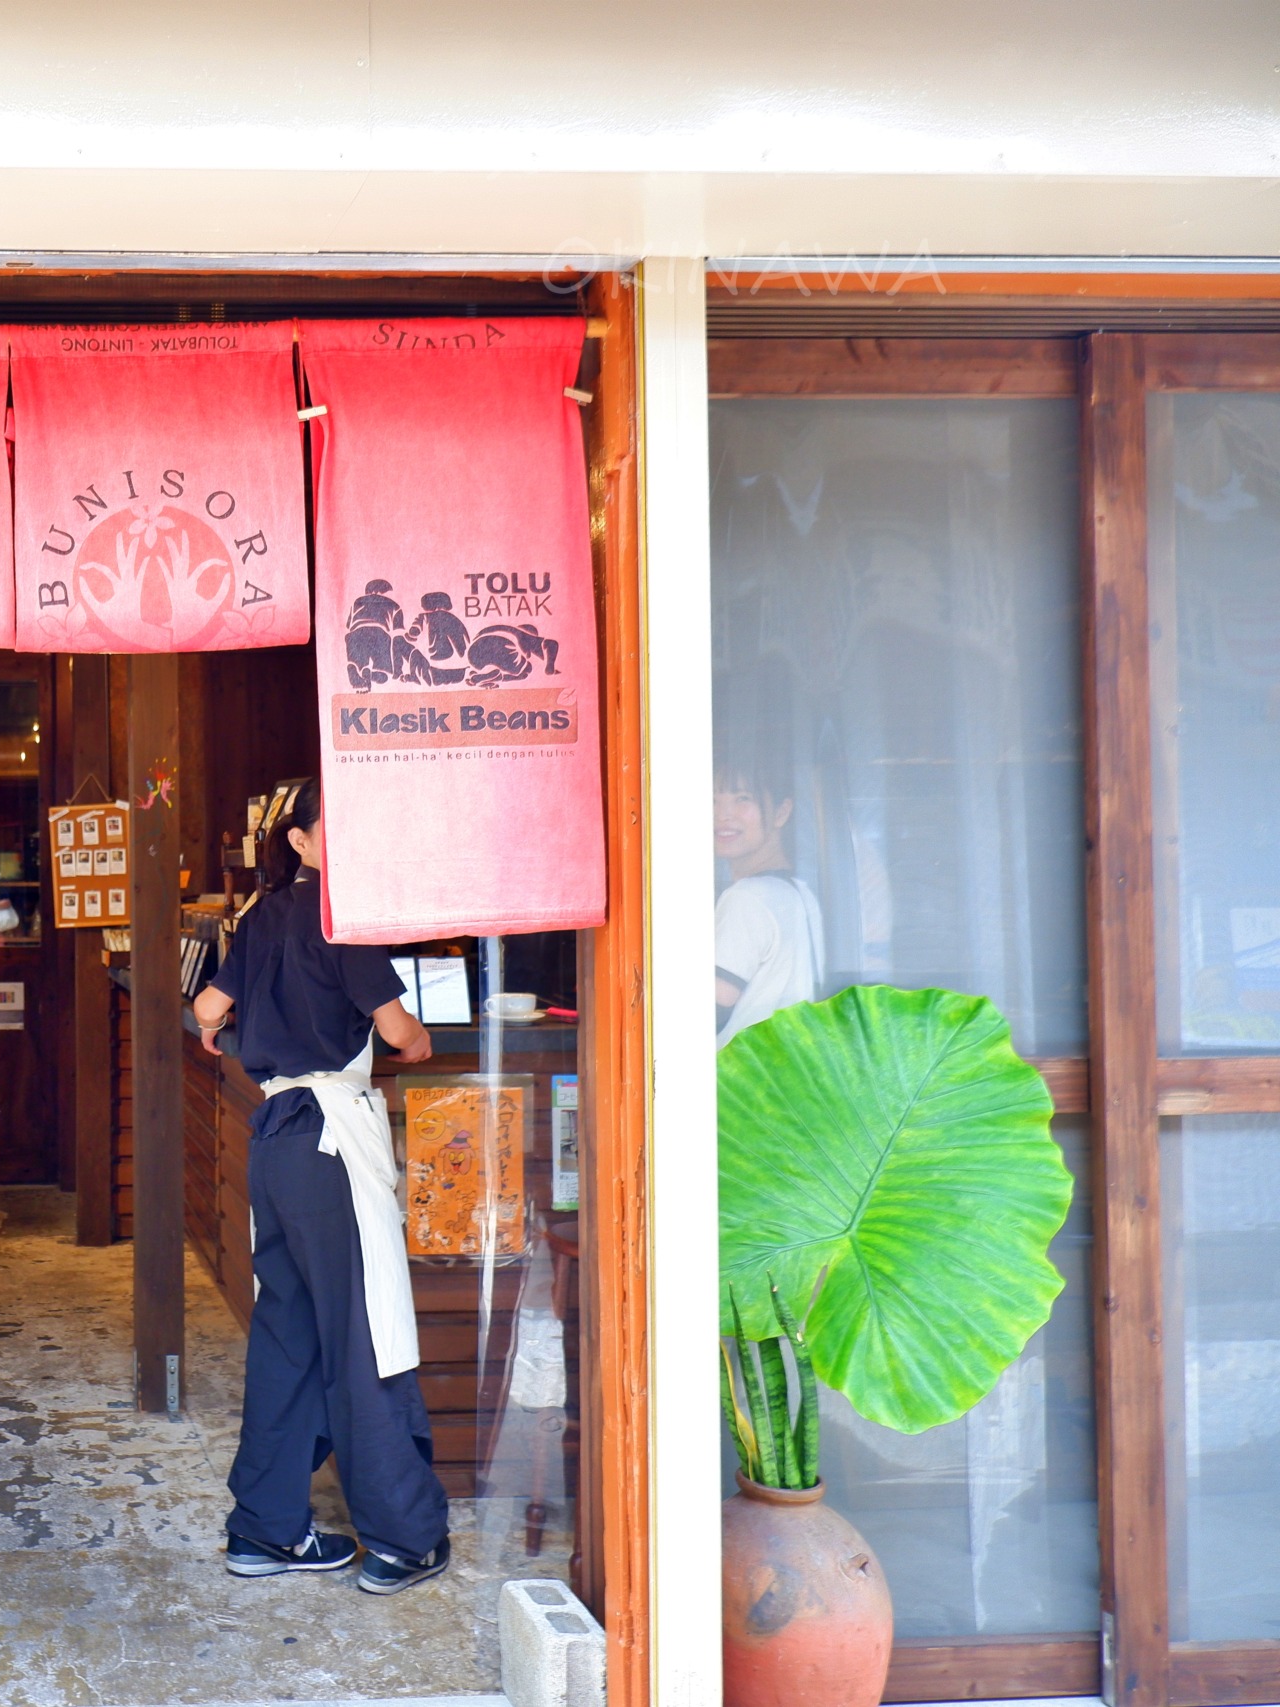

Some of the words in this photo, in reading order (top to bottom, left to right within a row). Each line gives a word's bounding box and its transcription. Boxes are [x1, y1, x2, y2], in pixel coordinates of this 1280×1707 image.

[61, 337, 134, 352] LINTONG
[151, 336, 239, 352] TOLUBATAK
[38, 469, 273, 609] BUNISORA
[464, 572, 551, 595] TOLU
[464, 595, 552, 617] BATAK
[340, 707, 451, 735] Klasik
[459, 705, 571, 732] Beans
[394, 752, 441, 762] hal-ha
[447, 750, 482, 760] kecil
[487, 750, 535, 761] dengan
